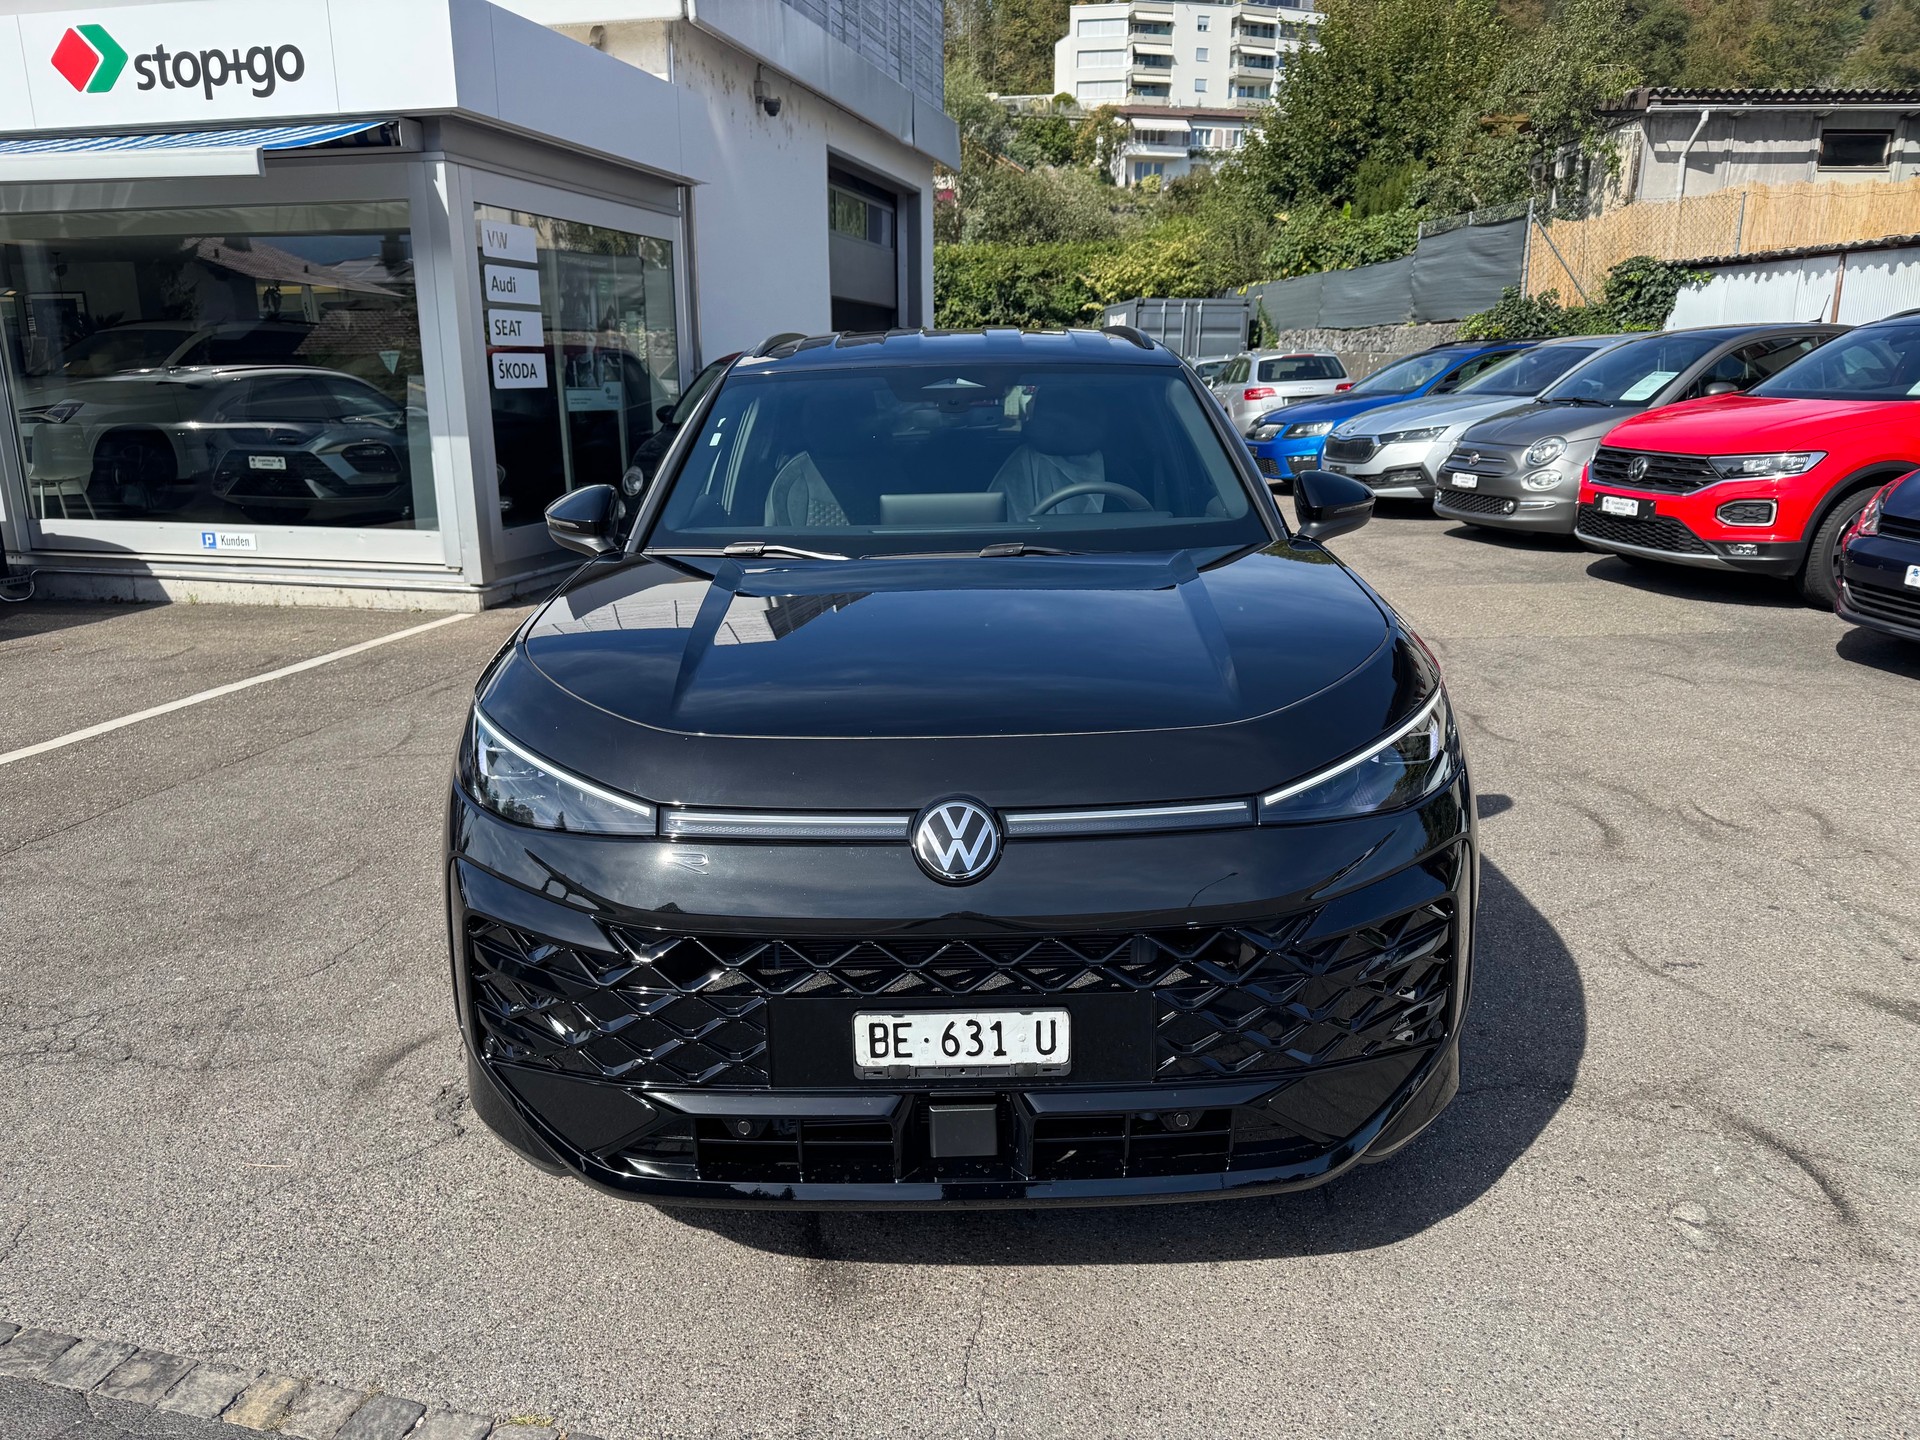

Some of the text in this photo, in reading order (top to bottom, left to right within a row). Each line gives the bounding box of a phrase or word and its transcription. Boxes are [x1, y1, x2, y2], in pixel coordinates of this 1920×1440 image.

[134, 44, 305, 100] stop+go
[487, 229, 508, 249] VW
[491, 275, 516, 293] Audi
[495, 319, 522, 337] SEAT
[498, 358, 538, 379] ŠKODA
[220, 535, 250, 547] Kunden
[868, 1019, 1057, 1059] BE 631 U
